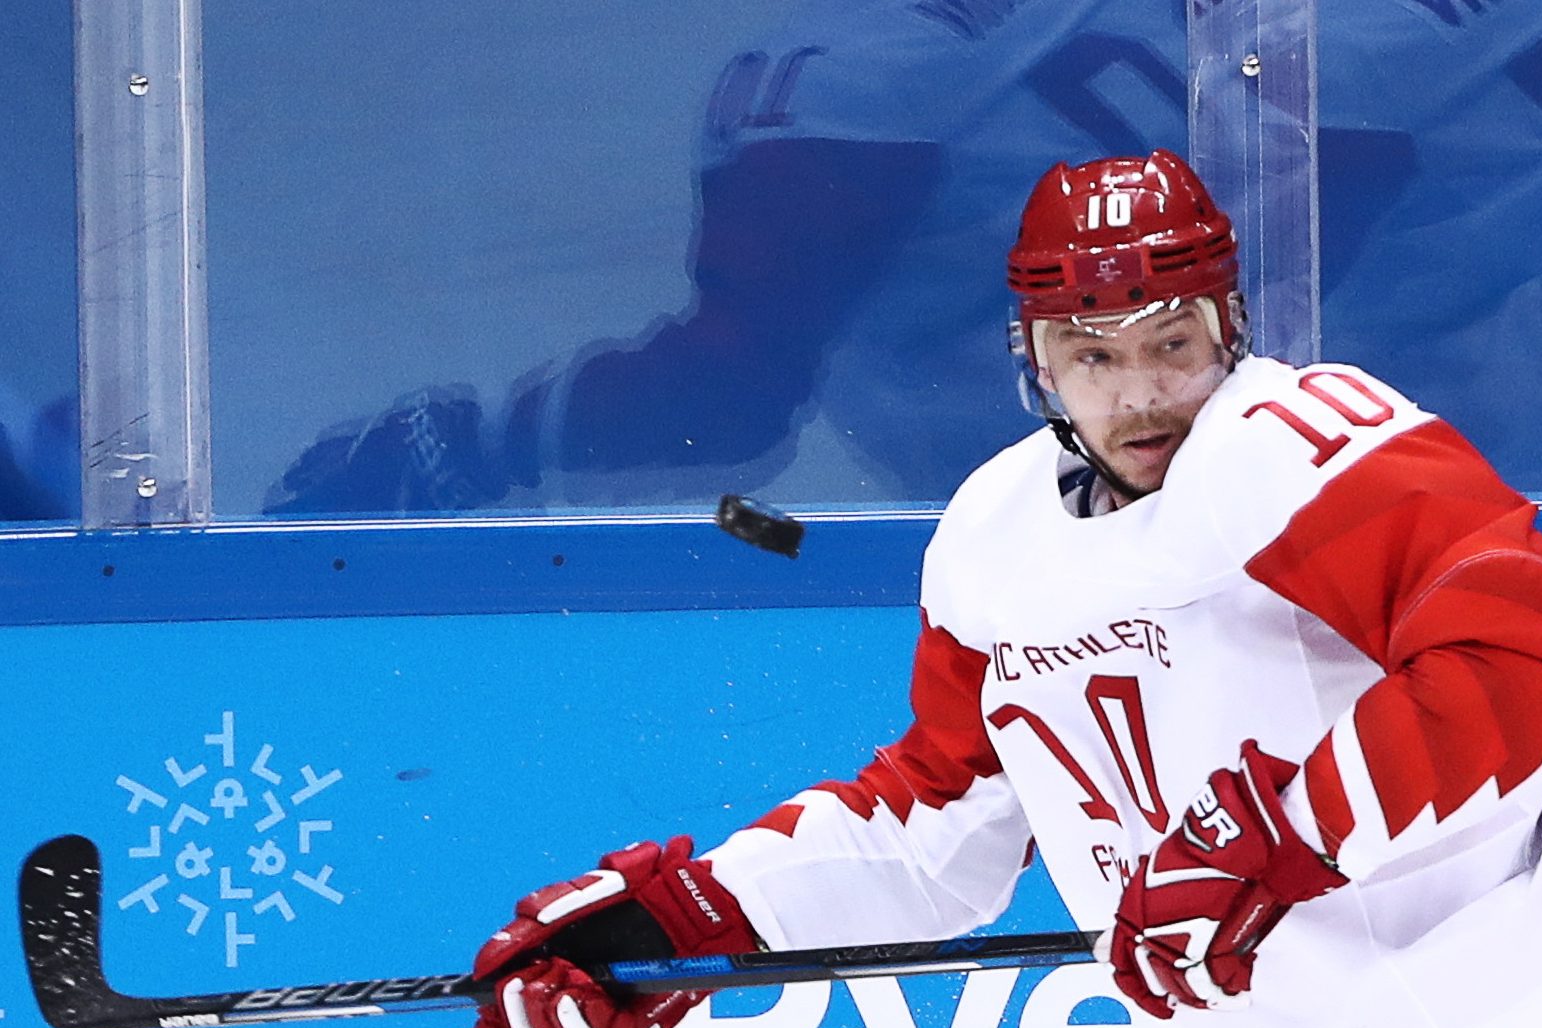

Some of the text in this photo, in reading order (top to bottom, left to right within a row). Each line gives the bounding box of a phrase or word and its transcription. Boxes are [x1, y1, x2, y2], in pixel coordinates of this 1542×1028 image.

[1087, 193, 1132, 230] 10
[1241, 371, 1394, 468] 10
[993, 619, 1171, 682] IC ATHLETE
[986, 674, 1170, 835] 10
[676, 868, 722, 923] BAUER
